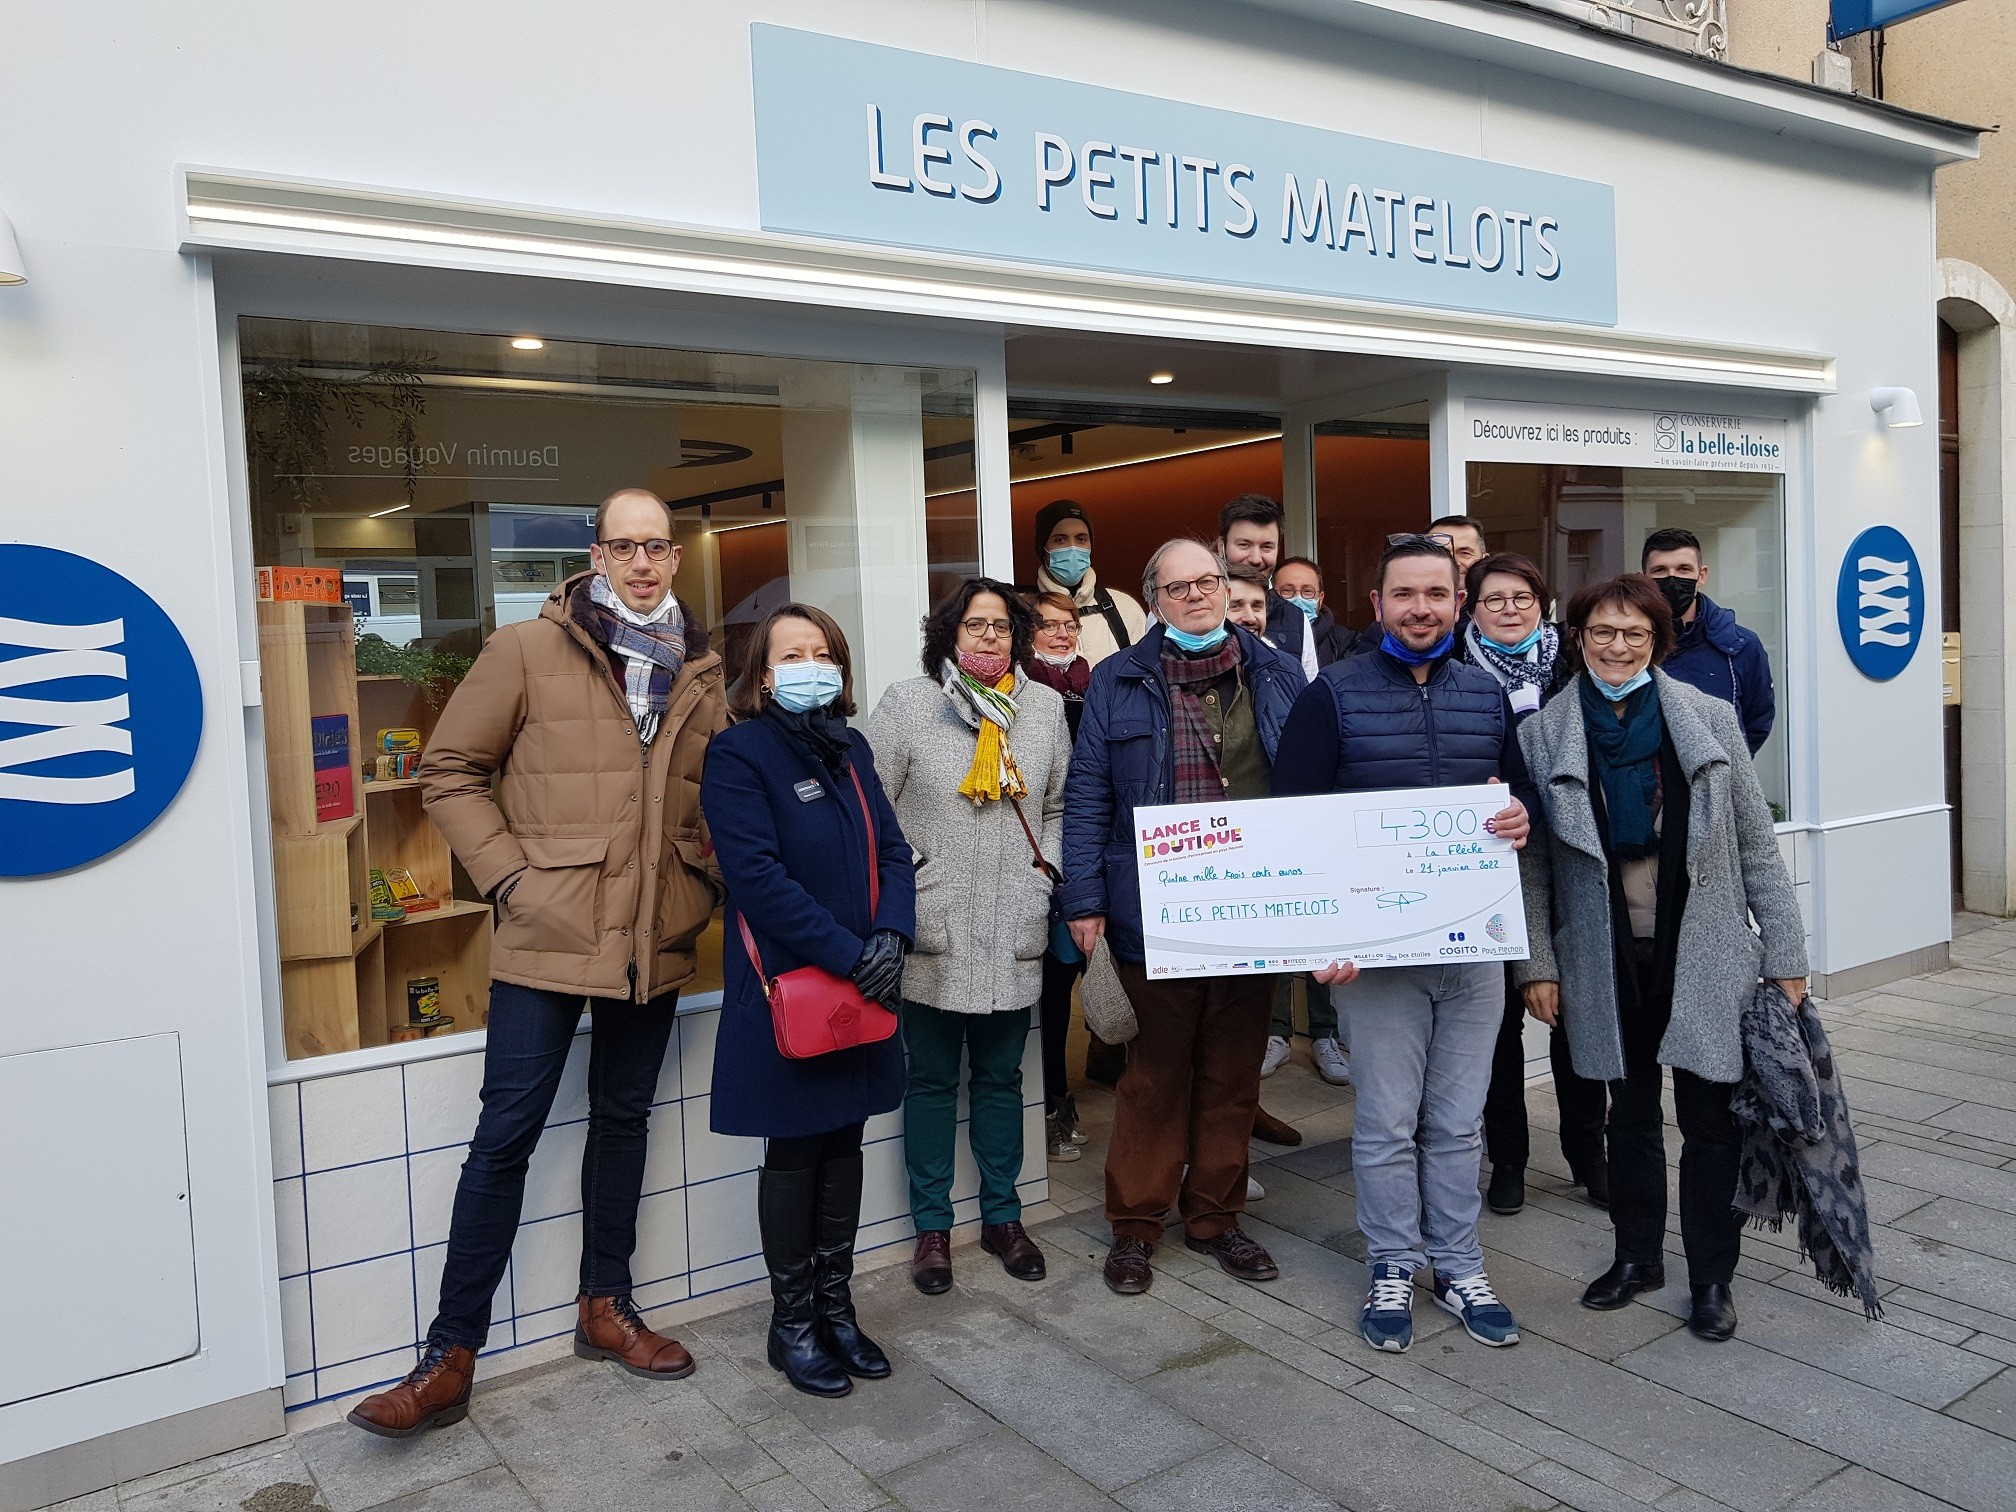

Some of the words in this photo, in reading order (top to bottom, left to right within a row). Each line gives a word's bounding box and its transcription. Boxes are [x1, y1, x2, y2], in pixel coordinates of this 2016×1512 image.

[866, 103, 1001, 204] LES
[1034, 131, 1258, 239] PETITS
[1280, 172, 1561, 281] MATELOTS
[1473, 419, 1542, 441] Découvrez
[1546, 423, 1559, 442] ici
[1562, 424, 1579, 443] les
[1583, 426, 1631, 447] produits
[1680, 414, 1741, 430] CONSERVERIE
[1681, 430, 1694, 454] la
[1698, 431, 1780, 458] belle-iloise
[1671, 458, 1708, 467] savoir-faire
[1141, 819, 1201, 842] LANCE
[1210, 816, 1228, 829] ta
[1380, 808, 1477, 841] 4300
[1143, 827, 1242, 859] BOUTIQUE
[1193, 866, 1218, 881] mille
[1278, 867, 1303, 877] euros
[1420, 863, 1435, 874] 21
[1478, 859, 1500, 869] 2022
[1350, 886, 1381, 894] Signature
[1179, 906, 1202, 923] LES
[1211, 903, 1258, 921] PETITS
[1264, 898, 1340, 918] MATELOTS
[1439, 945, 1478, 956] COGITO
